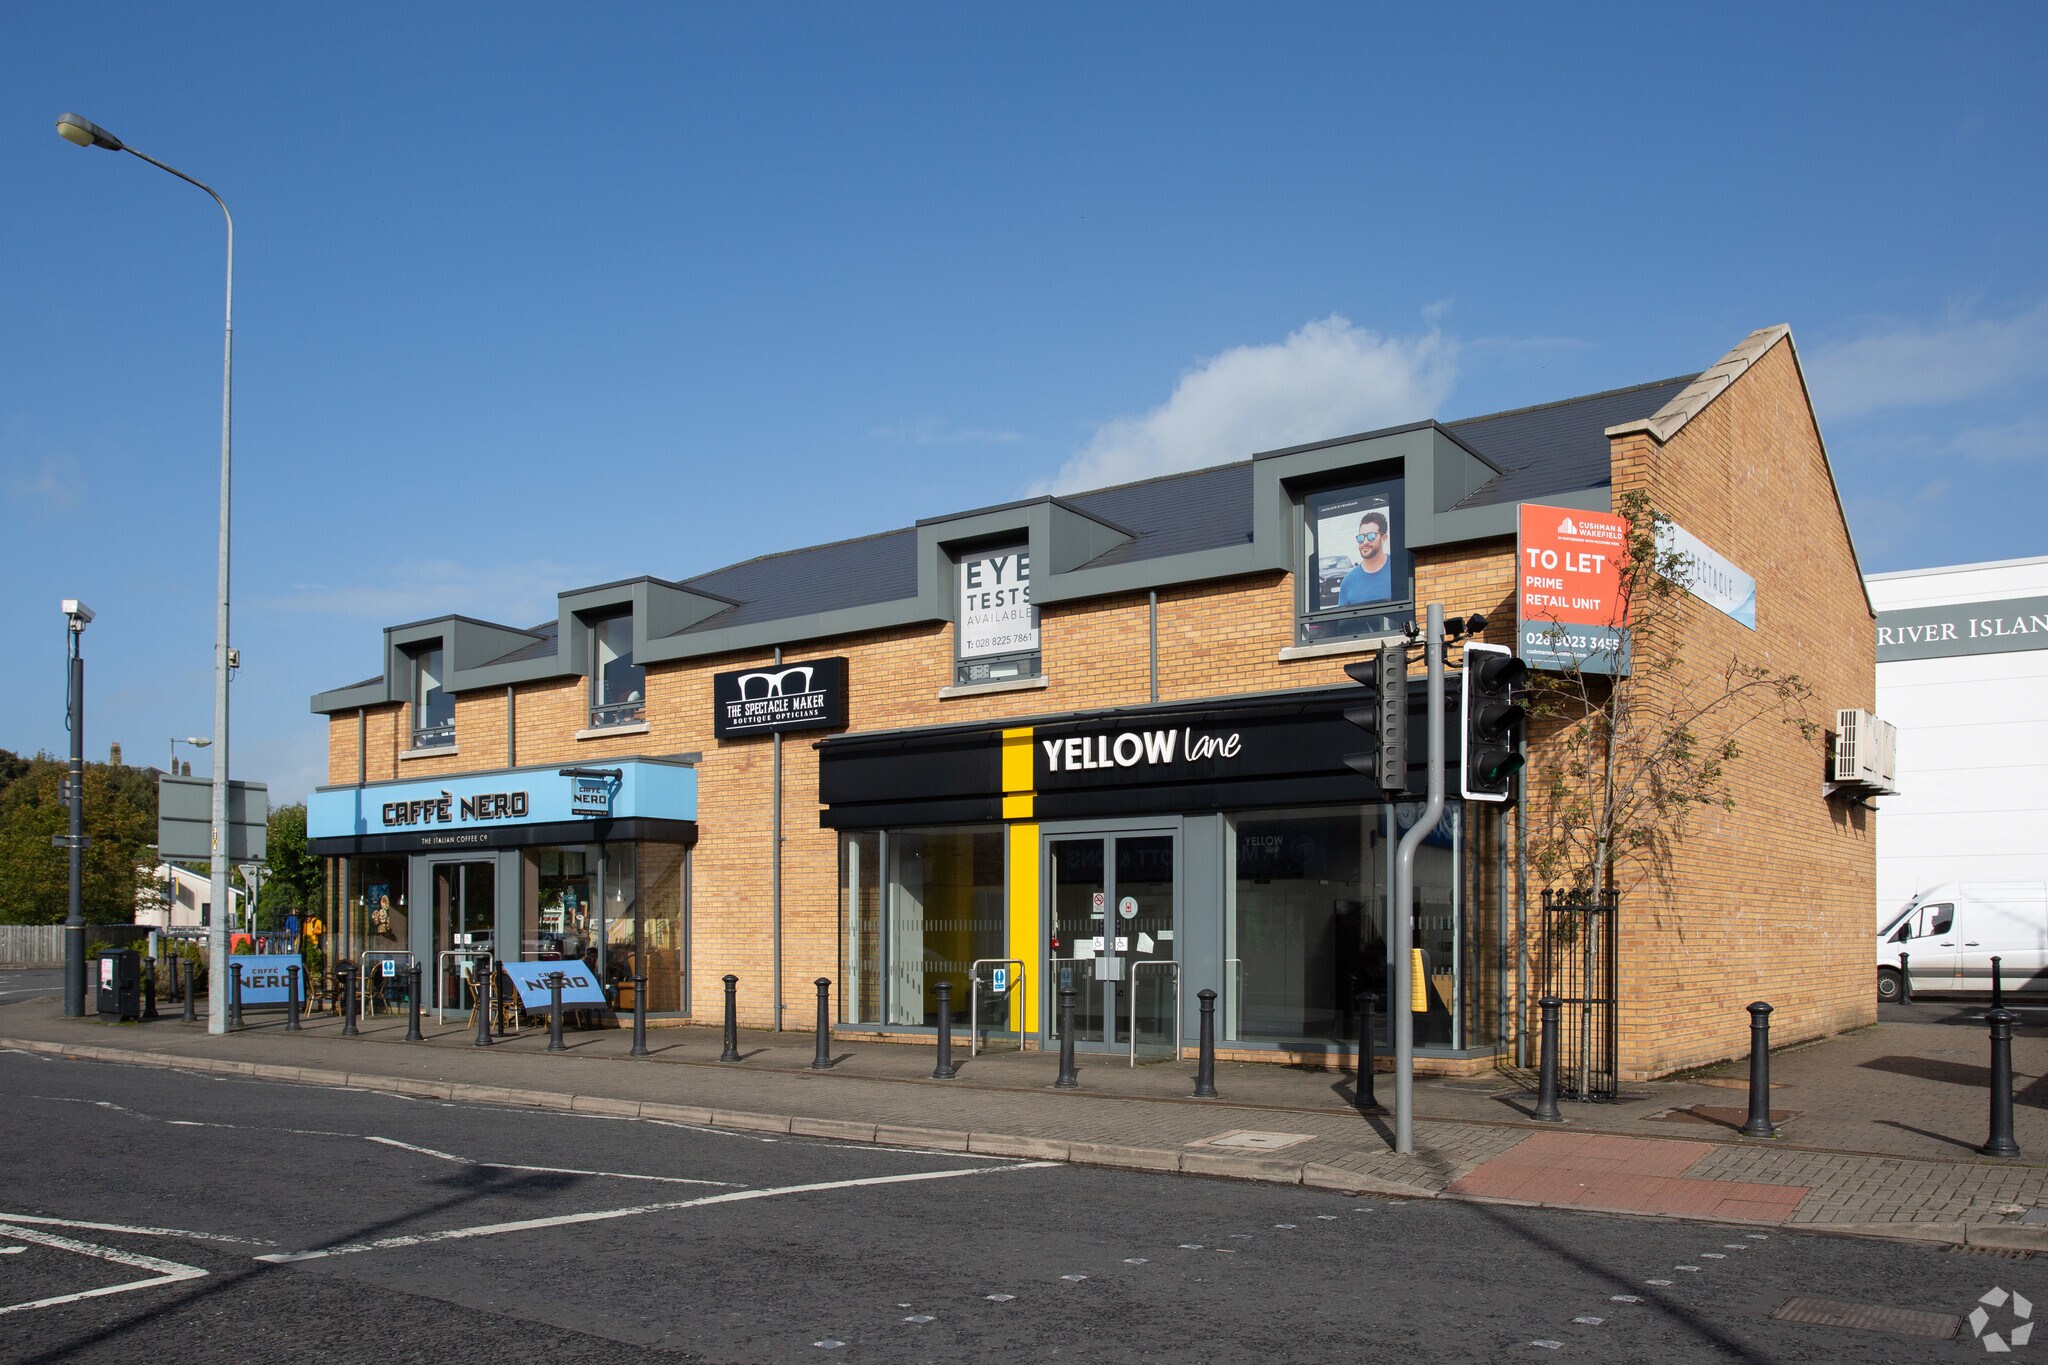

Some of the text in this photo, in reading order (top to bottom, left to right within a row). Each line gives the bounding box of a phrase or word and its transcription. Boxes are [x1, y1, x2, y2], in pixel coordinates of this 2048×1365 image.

[1337, 501, 1358, 509] EYEWEAR
[1578, 521, 1616, 532] CUSHMAN
[1578, 529, 1623, 540] WAKEFIELD
[1526, 548, 1606, 574] TO LET
[967, 552, 1029, 589] EYE
[1526, 576, 1564, 590] PRIME
[967, 586, 1030, 611] TESTS
[1526, 594, 1600, 610] RETAIL UNIT
[967, 608, 1032, 626] AVAILABLE
[1876, 614, 2048, 646] RIVER ISLAN
[967, 632, 1032, 649] T: 028 8225 7861
[1526, 632, 1550, 646] 028
[1590, 637, 1620, 650] 3455
[727, 694, 824, 718] THE SPECTACLE MAKER
[733, 709, 819, 724] BOUTIQUE OPTICIANS
[1042, 727, 1242, 772] YELLOW lane
[574, 794, 606, 804] NERO
[382, 789, 529, 826] CAFFÈ NERO
[433, 836, 455, 844] ITALIAN
[1245, 836, 1284, 846] YELLOW
[240, 975, 290, 988] NERO
[524, 976, 589, 991] NERO
